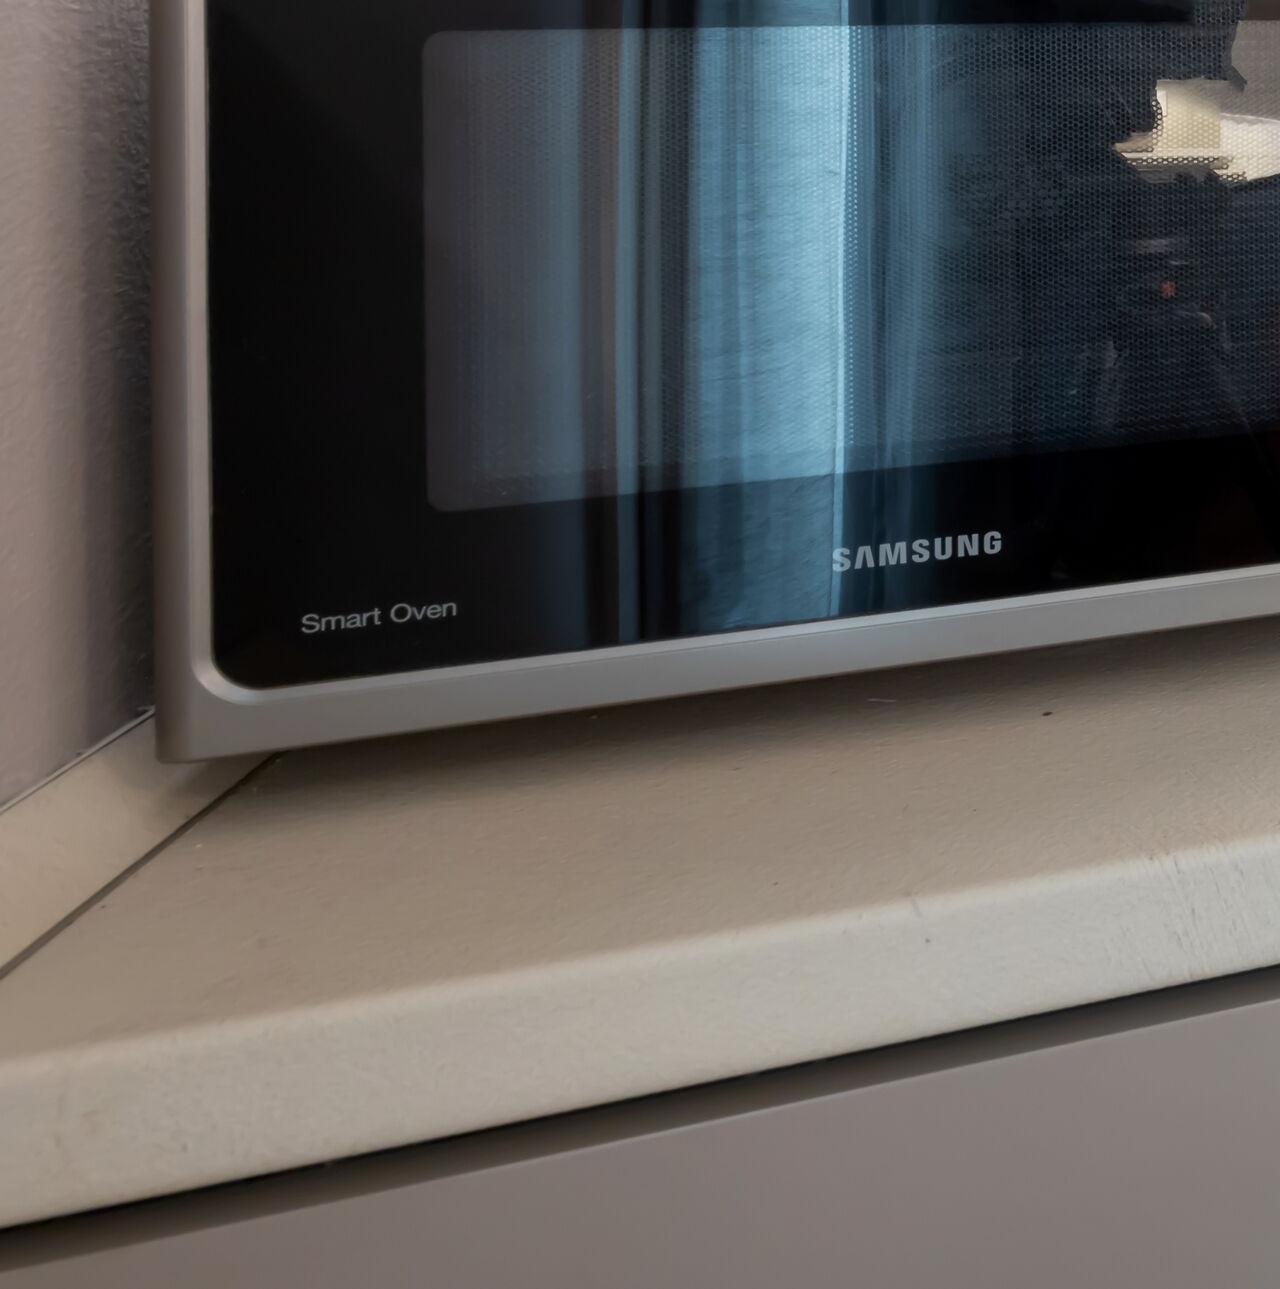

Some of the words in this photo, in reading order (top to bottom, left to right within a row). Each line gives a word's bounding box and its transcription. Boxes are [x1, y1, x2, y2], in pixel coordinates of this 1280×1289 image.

[832, 530, 1002, 573] SAMSUNG
[301, 608, 382, 634] Smart
[390, 602, 457, 623] Oven
